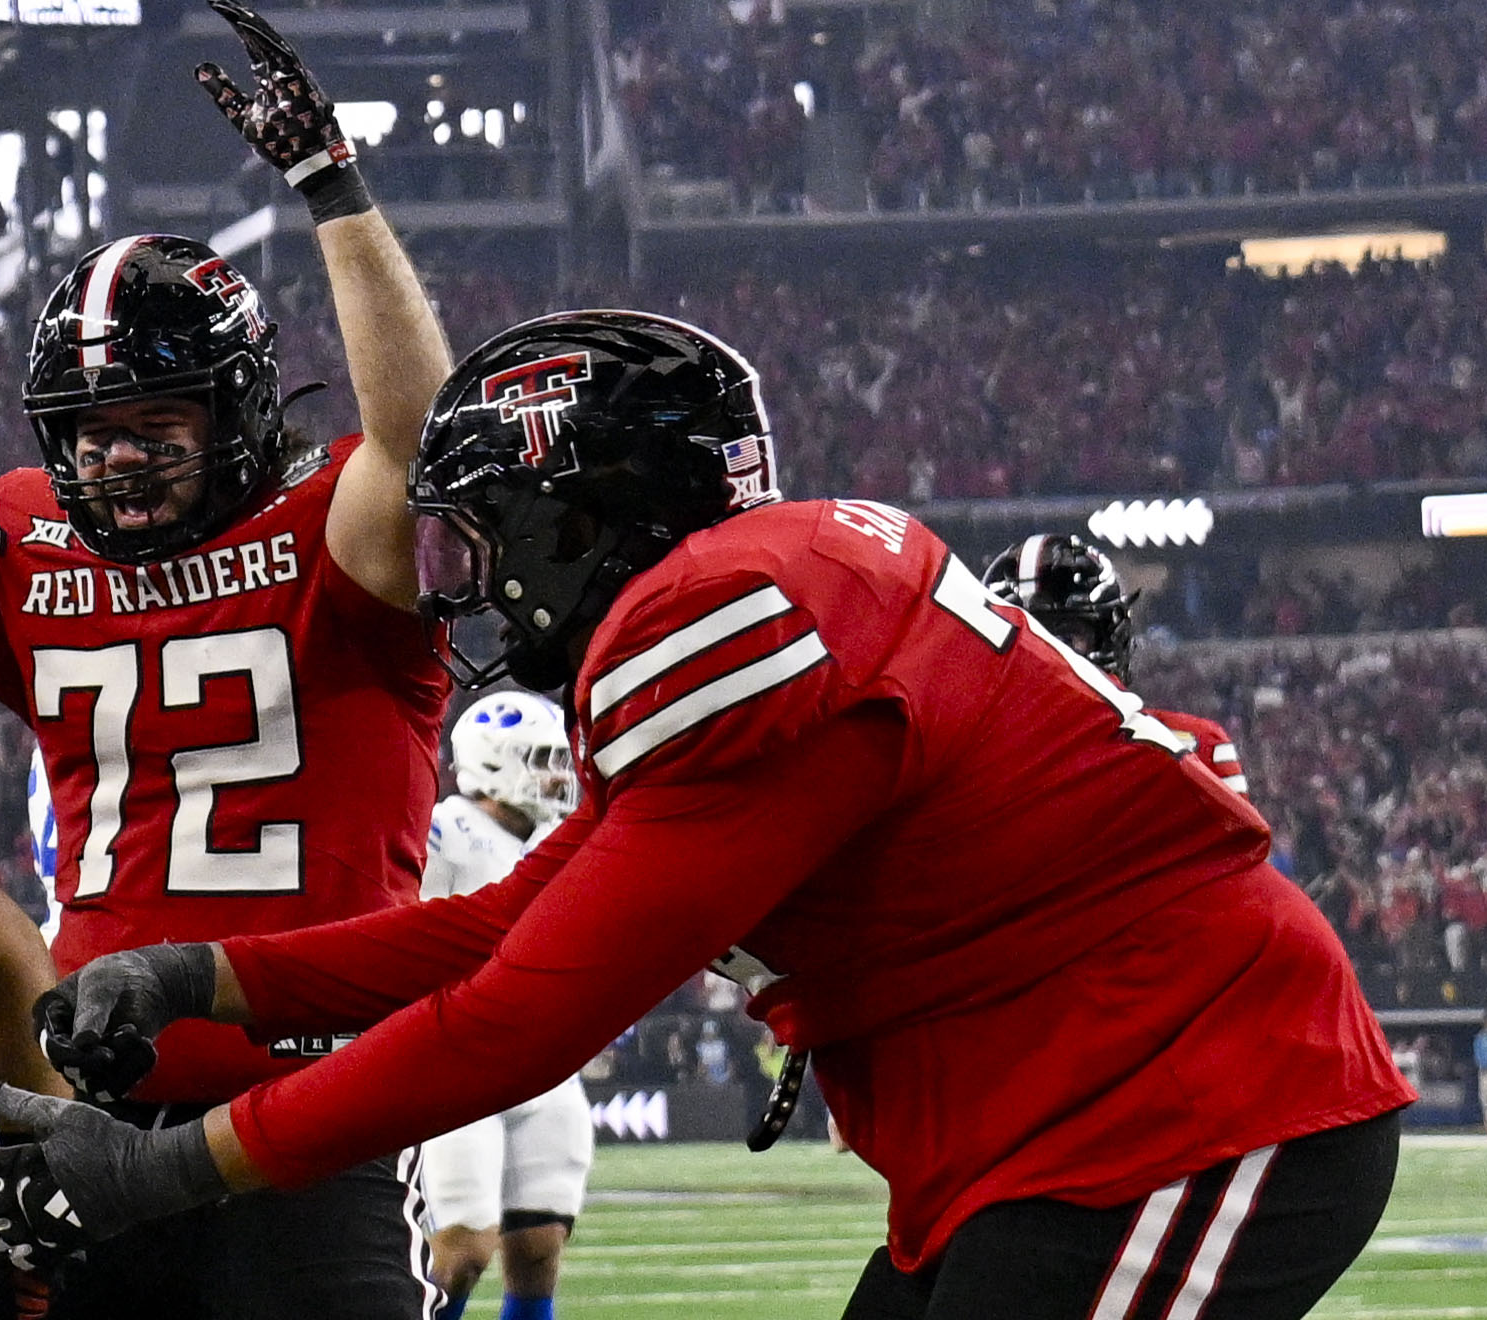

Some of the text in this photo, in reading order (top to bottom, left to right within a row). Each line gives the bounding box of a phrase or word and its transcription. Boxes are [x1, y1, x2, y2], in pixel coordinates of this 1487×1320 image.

[21, 517, 72, 549] XII
[22, 532, 299, 616] RED RAIDERS
[32, 627, 301, 899] 72
[312, 1038, 324, 1050] XL
